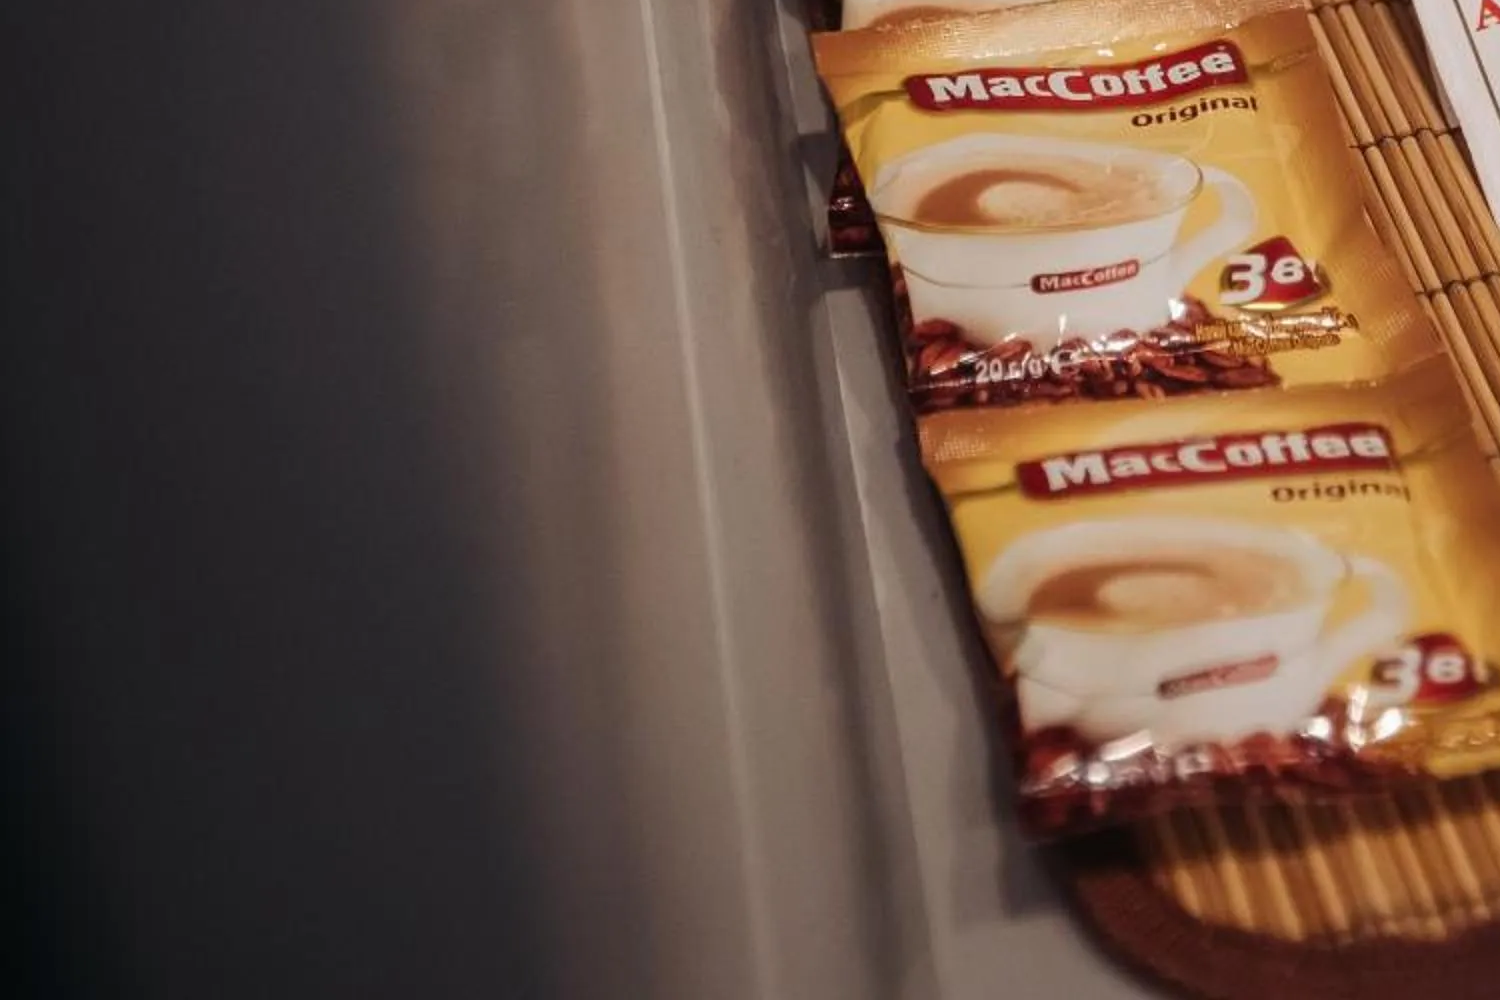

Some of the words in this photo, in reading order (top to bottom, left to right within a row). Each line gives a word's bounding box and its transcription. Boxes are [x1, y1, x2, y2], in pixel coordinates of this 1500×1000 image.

[926, 51, 1237, 102] MacCoffee
[1131, 95, 1258, 129] Original
[1041, 430, 1389, 492] MacCoffee
